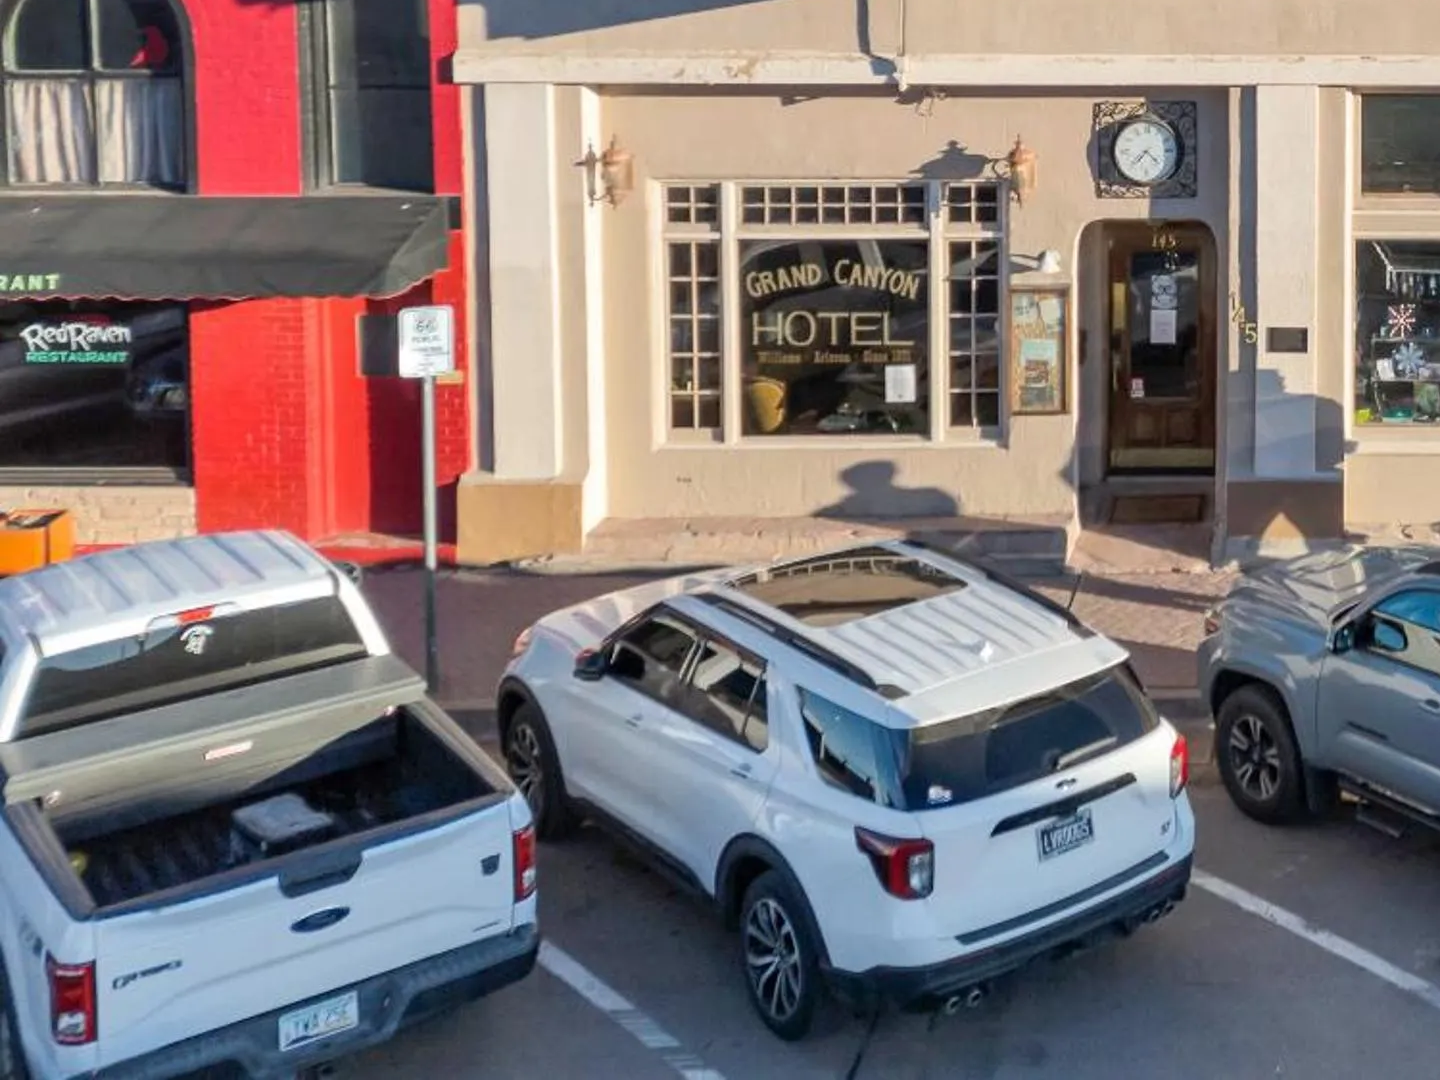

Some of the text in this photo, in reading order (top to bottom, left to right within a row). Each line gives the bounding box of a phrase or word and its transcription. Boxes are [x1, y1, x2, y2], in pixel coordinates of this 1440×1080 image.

[746, 259, 920, 300] GRAND CANYON
[751, 310, 916, 347] HOTEL
[25, 351, 129, 363] RESTAURANT
